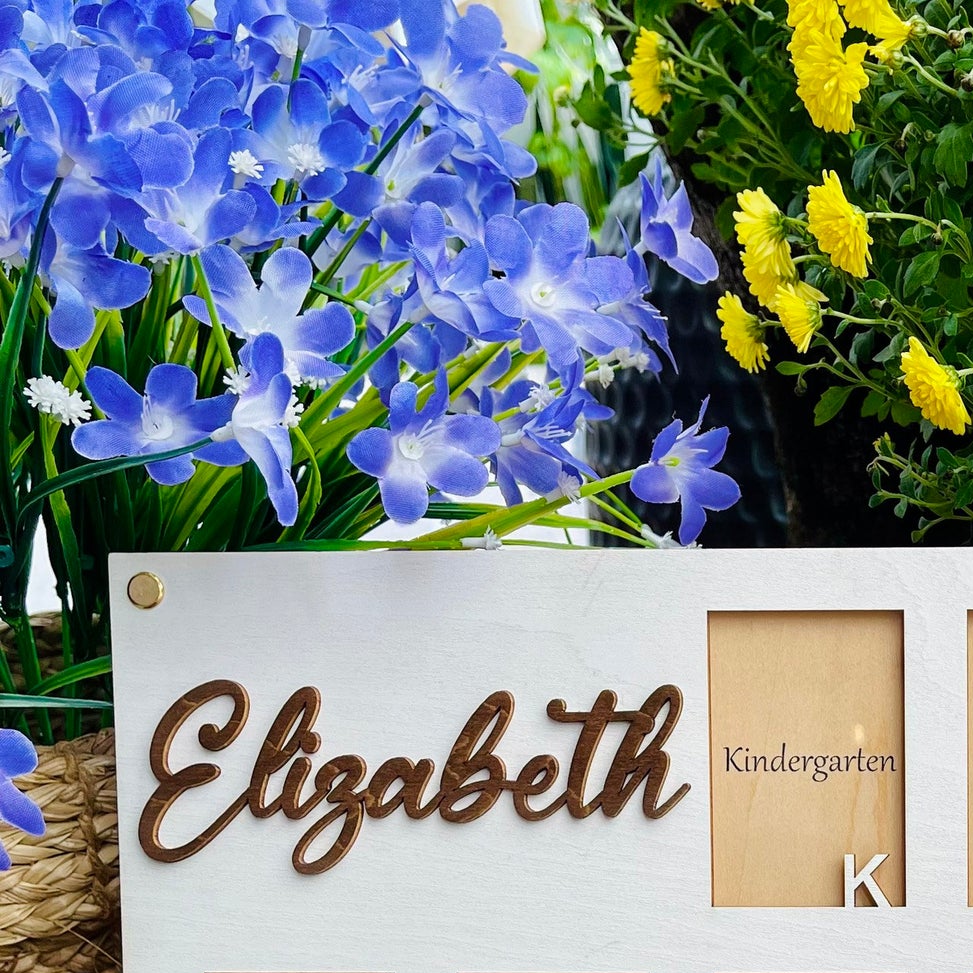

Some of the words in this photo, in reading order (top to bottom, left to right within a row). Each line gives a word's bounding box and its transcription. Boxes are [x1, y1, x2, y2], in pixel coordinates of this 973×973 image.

[138, 679, 691, 875] Elizabeth
[723, 743, 897, 782] Kindergarten
[843, 853, 893, 907] K
